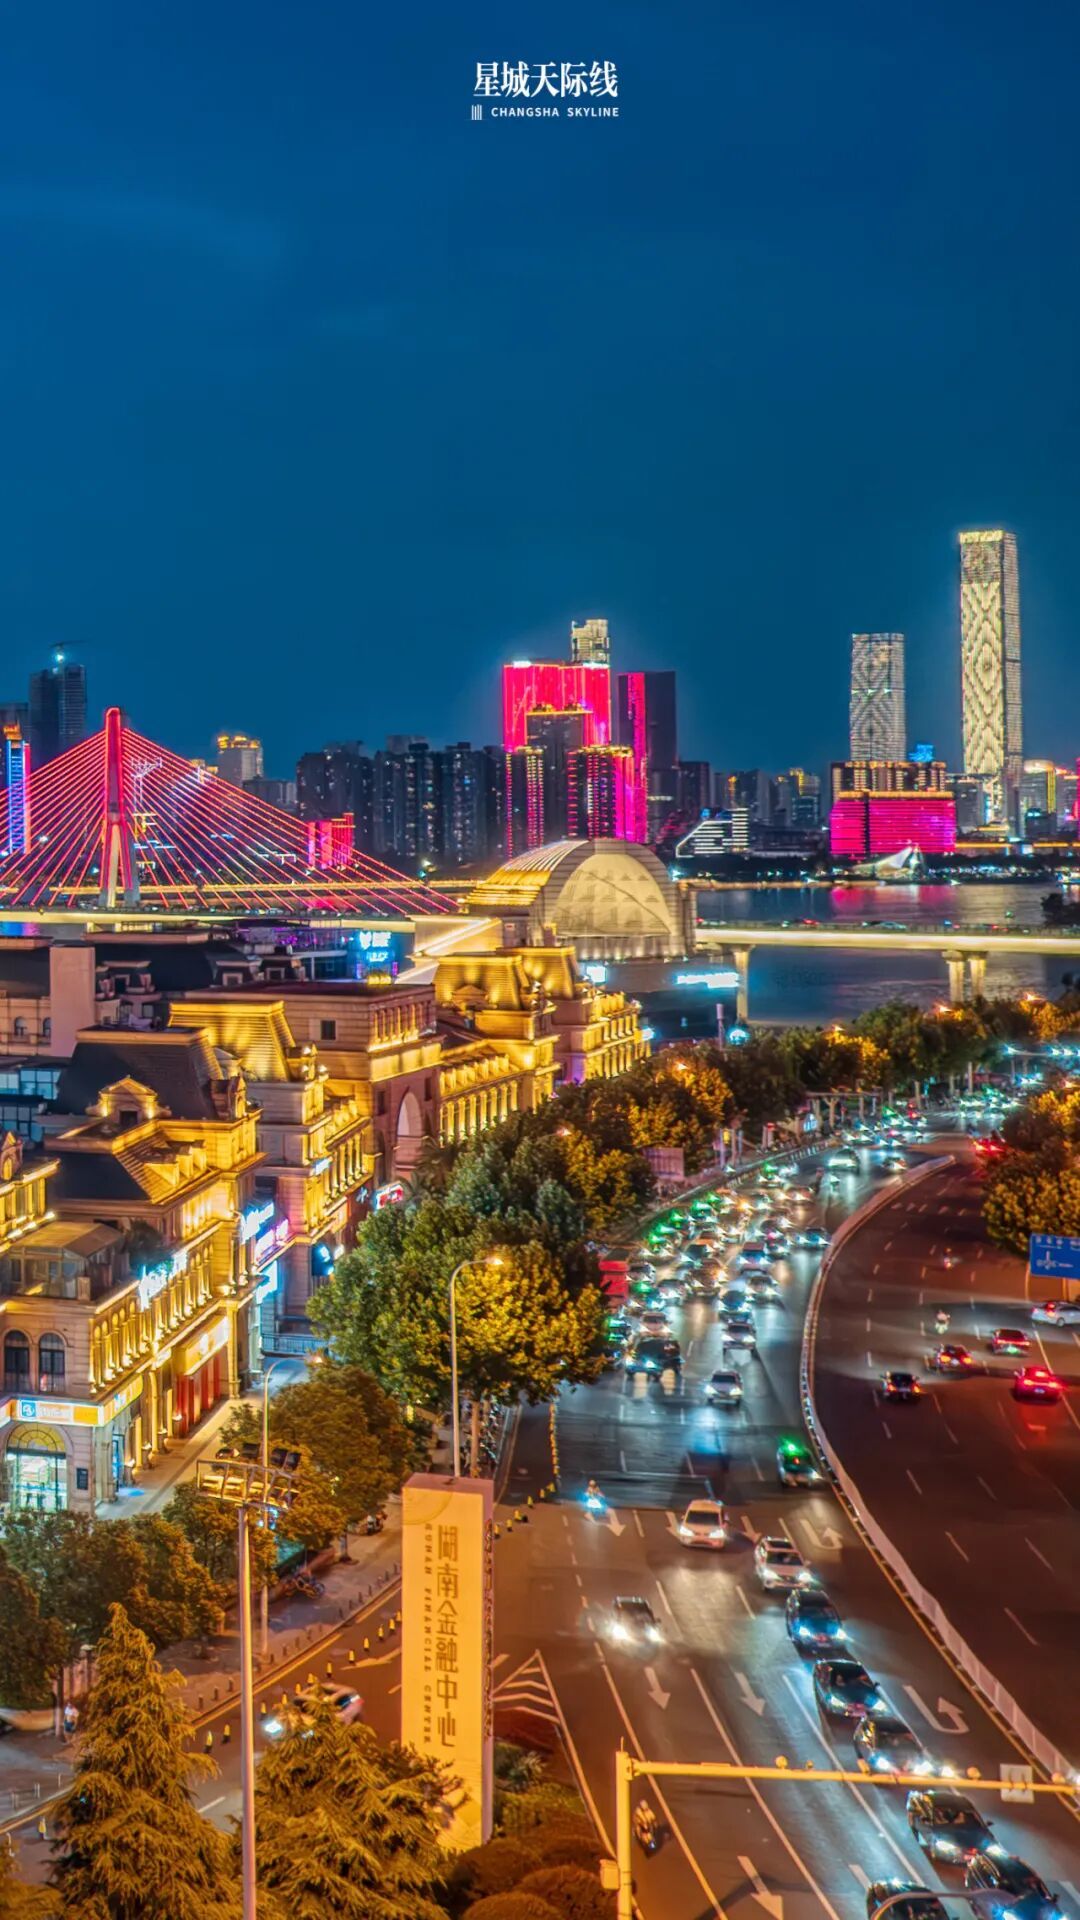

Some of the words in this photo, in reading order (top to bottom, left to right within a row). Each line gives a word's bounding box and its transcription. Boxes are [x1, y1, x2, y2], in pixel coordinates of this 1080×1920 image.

[424, 1523, 433, 1576] HUNAN
[423, 1587, 433, 1674] FINANCIAL
[435, 1524, 459, 1748] 湖南金融中心
[423, 1684, 432, 1744] CENTER
